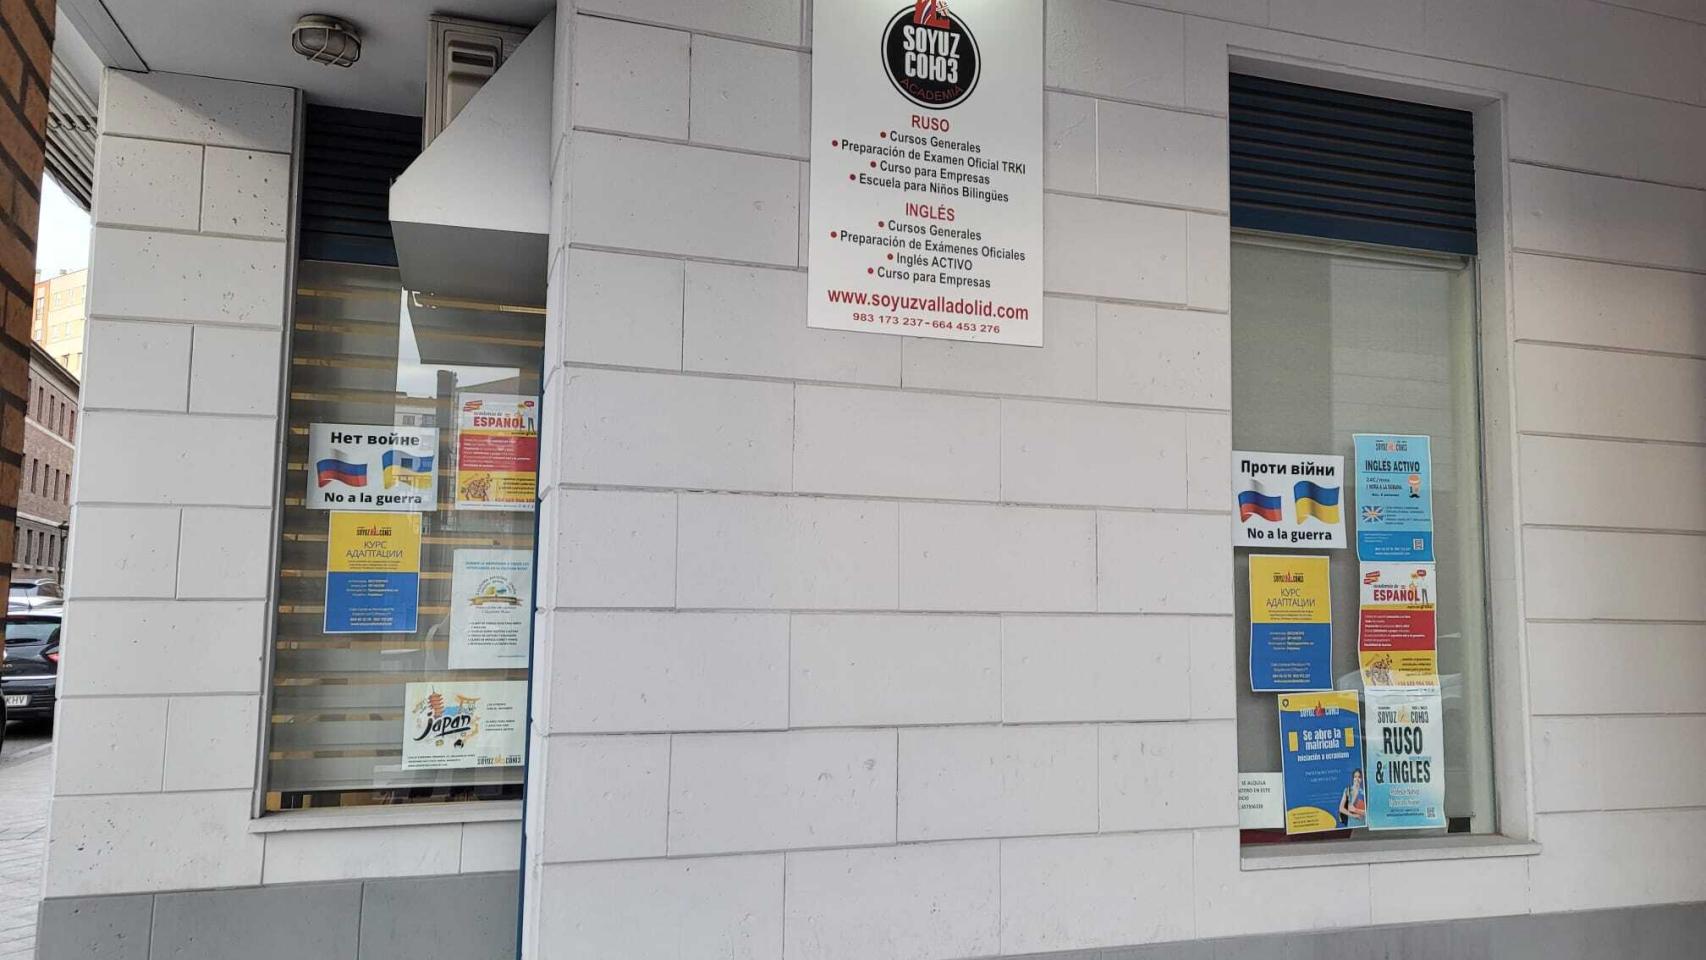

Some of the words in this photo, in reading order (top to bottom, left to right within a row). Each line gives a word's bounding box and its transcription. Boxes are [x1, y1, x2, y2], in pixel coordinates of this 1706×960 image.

[903, 25, 960, 58] SOYUZ
[905, 52, 959, 84] СОЮЗ
[900, 78, 964, 101] ACADEMIA
[912, 115, 950, 132] RUSO
[890, 131, 927, 146] Cursos
[930, 137, 981, 154] Generales
[841, 139, 905, 159] Preparación
[908, 149, 920, 160] de
[924, 151, 964, 166] Examen
[967, 157, 999, 171] Oficial
[1002, 161, 1026, 175] TRKI
[880, 161, 911, 175] Curso
[915, 166, 937, 179] para
[940, 168, 990, 185] Empresas
[859, 174, 901, 189] Escuela
[904, 180, 927, 193] para
[930, 183, 959, 196] Niños
[963, 187, 1009, 203] Bilingües
[906, 202, 955, 222] INGLÉS
[888, 220, 926, 235] Cursos
[929, 226, 982, 241] Generales
[840, 230, 905, 249] Preparación
[909, 238, 921, 249] de
[925, 241, 978, 256] Exámenes
[982, 246, 1025, 261] Oficiales
[897, 252, 929, 268] Inglés
[931, 257, 972, 270] ACTIVO
[877, 267, 909, 280] Curso
[913, 272, 936, 284] para
[939, 275, 991, 289] Empresas
[828, 290, 1029, 320] www.soyuzvalladolid.com
[853, 312, 874, 323] 983
[879, 315, 899, 324] 173
[956, 322, 976, 331] 453
[980, 324, 1000, 334] 276
[474, 414, 525, 429] ESPAÑOL
[331, 432, 363, 444] Нет
[367, 432, 420, 446] войне
[1241, 460, 1286, 477] Проти
[1291, 462, 1334, 476] війни
[1394, 461, 1420, 472] ACTIVO
[324, 492, 344, 503] No
[348, 494, 356, 503] a
[360, 493, 372, 503] la
[376, 495, 422, 506] guerra
[1247, 528, 1264, 539] No
[1267, 530, 1274, 539] a
[1277, 528, 1287, 539] la
[1291, 530, 1332, 543] guerra
[346, 550, 403, 559] АДАПТАЦИИ
[1281, 588, 1300, 597] КУРС
[1374, 586, 1421, 602] ESPAÑOL
[1266, 598, 1315, 608] АДАПТАЦИИ
[1378, 711, 1397, 724] SOYUZ
[1303, 730, 1312, 741] Se
[1314, 728, 1332, 740] abre
[1334, 728, 1341, 739] la
[1383, 726, 1423, 755] RUSO
[1376, 760, 1384, 784] &
[1389, 760, 1431, 784] INGLES
